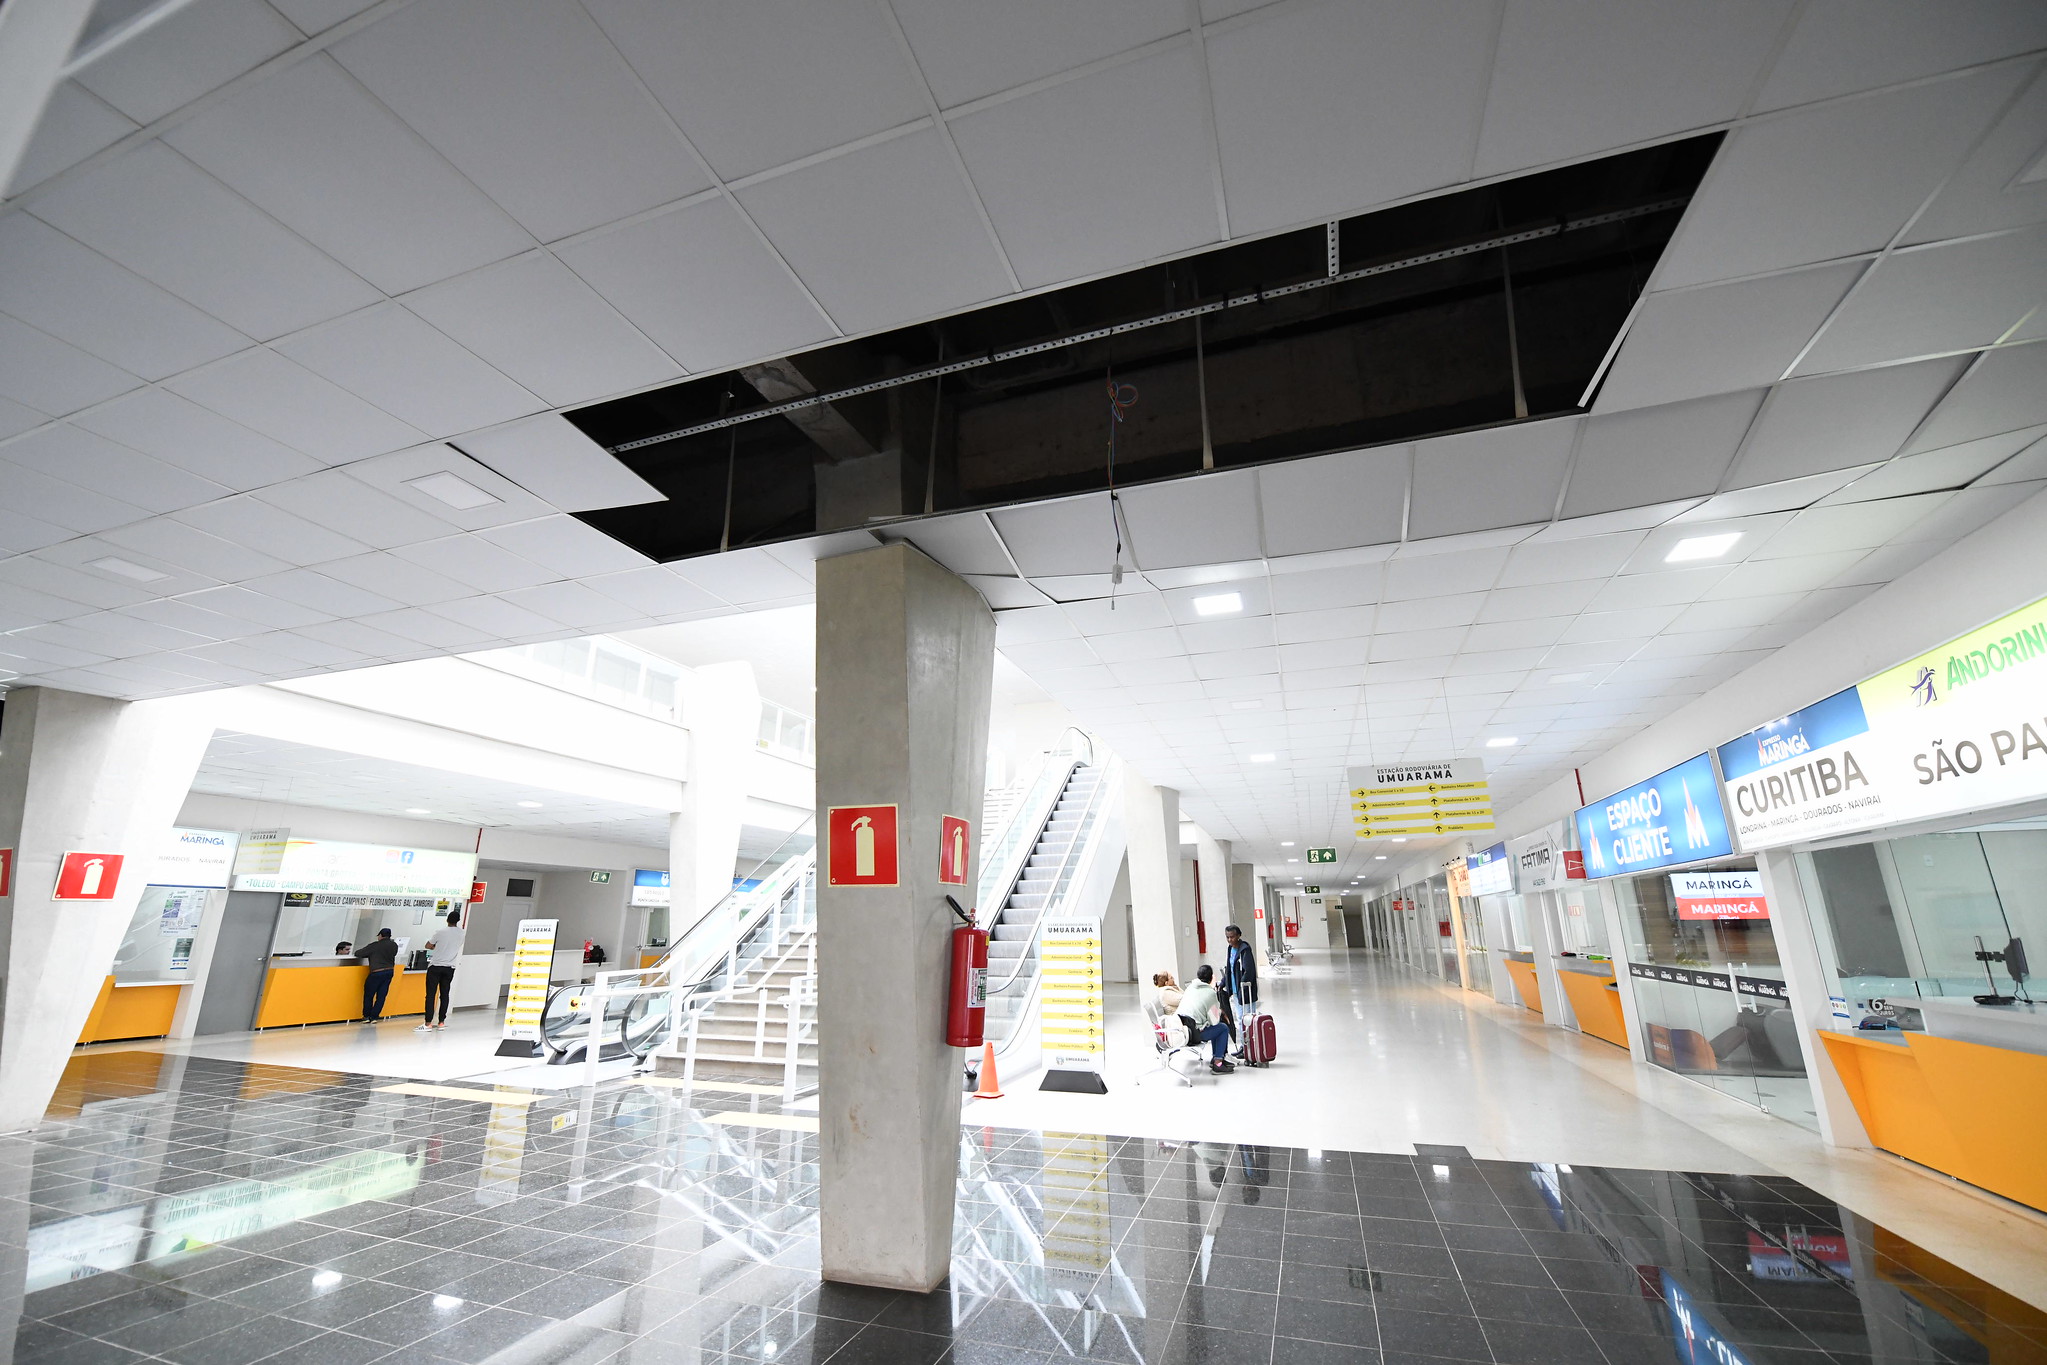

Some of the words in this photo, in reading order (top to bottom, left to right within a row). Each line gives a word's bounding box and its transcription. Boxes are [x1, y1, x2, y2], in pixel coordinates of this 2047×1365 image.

[1948, 623, 2047, 690] ANDORIN
[1758, 727, 1810, 767] MARINGÁ
[1913, 739, 1982, 785] SÃO
[1991, 717, 2047, 766] PA
[1377, 770, 1453, 783] UMUARAMA
[1737, 750, 1869, 817] CURITIBA
[1606, 788, 1661, 831] ESPAÇO
[1740, 822, 1767, 834] LONDRINA
[1803, 806, 1843, 820] DOURADOS
[1613, 826, 1673, 865] CLIENTE
[249, 879, 276, 888] TOLEDO
[304, 882, 329, 890] GRANDE
[325, 896, 341, 904] PAULO
[342, 897, 366, 905] CAMPINAS
[1686, 878, 1752, 890] MARINGÁ
[1691, 901, 1759, 914] MARINGÁ
